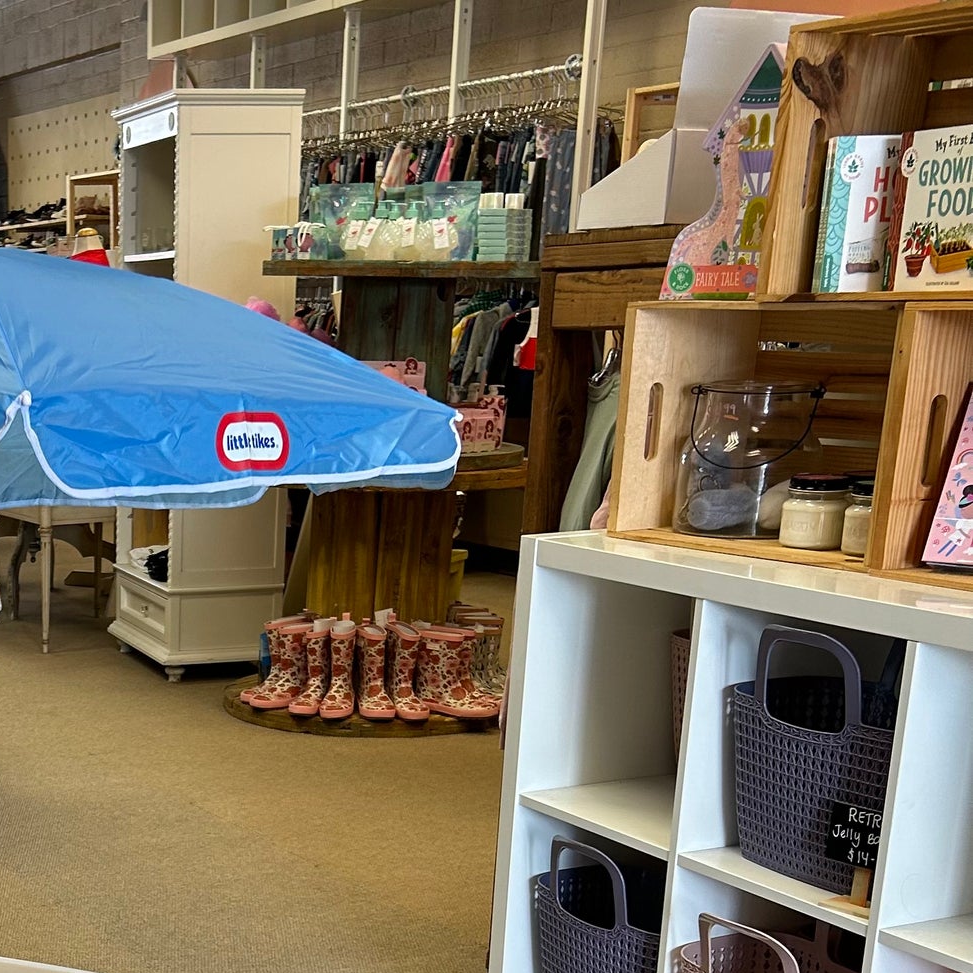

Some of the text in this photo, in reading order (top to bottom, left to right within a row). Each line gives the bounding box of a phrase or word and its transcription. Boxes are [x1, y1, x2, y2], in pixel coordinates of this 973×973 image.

[935, 138, 947, 153] My
[949, 134, 968, 147] First
[919, 156, 973, 187] GROWI
[863, 197, 890, 223] PL
[695, 271, 740, 287] FAIRY TALE
[251, 433, 276, 449] tikes
[848, 807, 882, 829] RETR
[832, 824, 861, 848] Jelly
